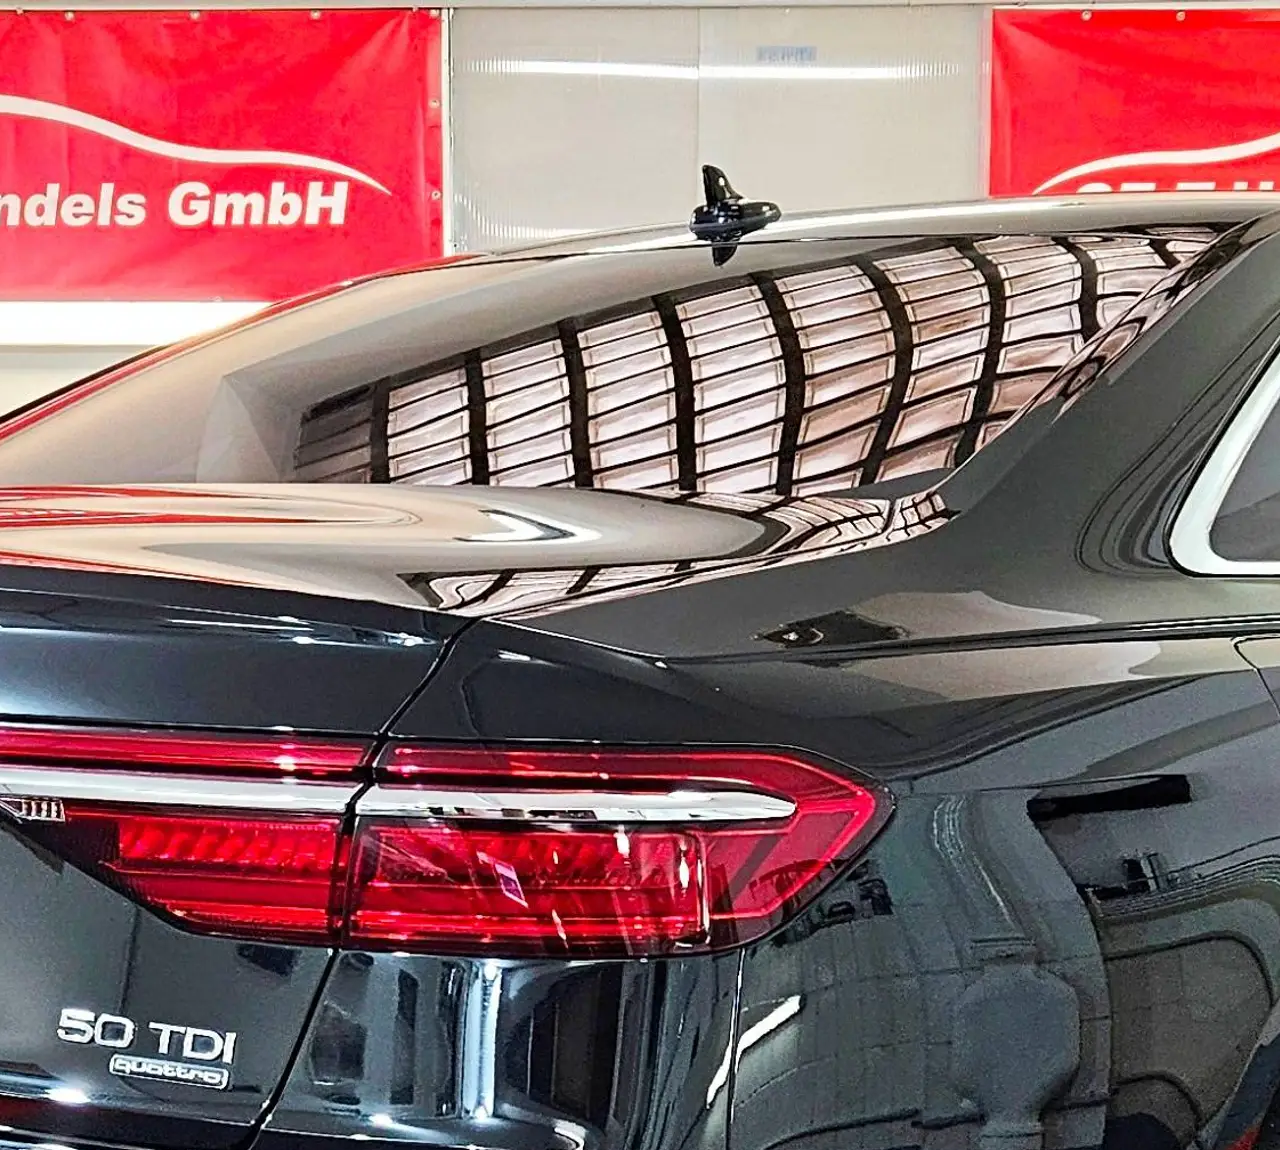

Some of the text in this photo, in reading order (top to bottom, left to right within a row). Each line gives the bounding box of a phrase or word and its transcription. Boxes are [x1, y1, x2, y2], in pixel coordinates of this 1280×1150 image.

[167, 181, 350, 227] GmbH
[57, 1008, 237, 1064] 50 TDI
[114, 1057, 222, 1084] quattro
